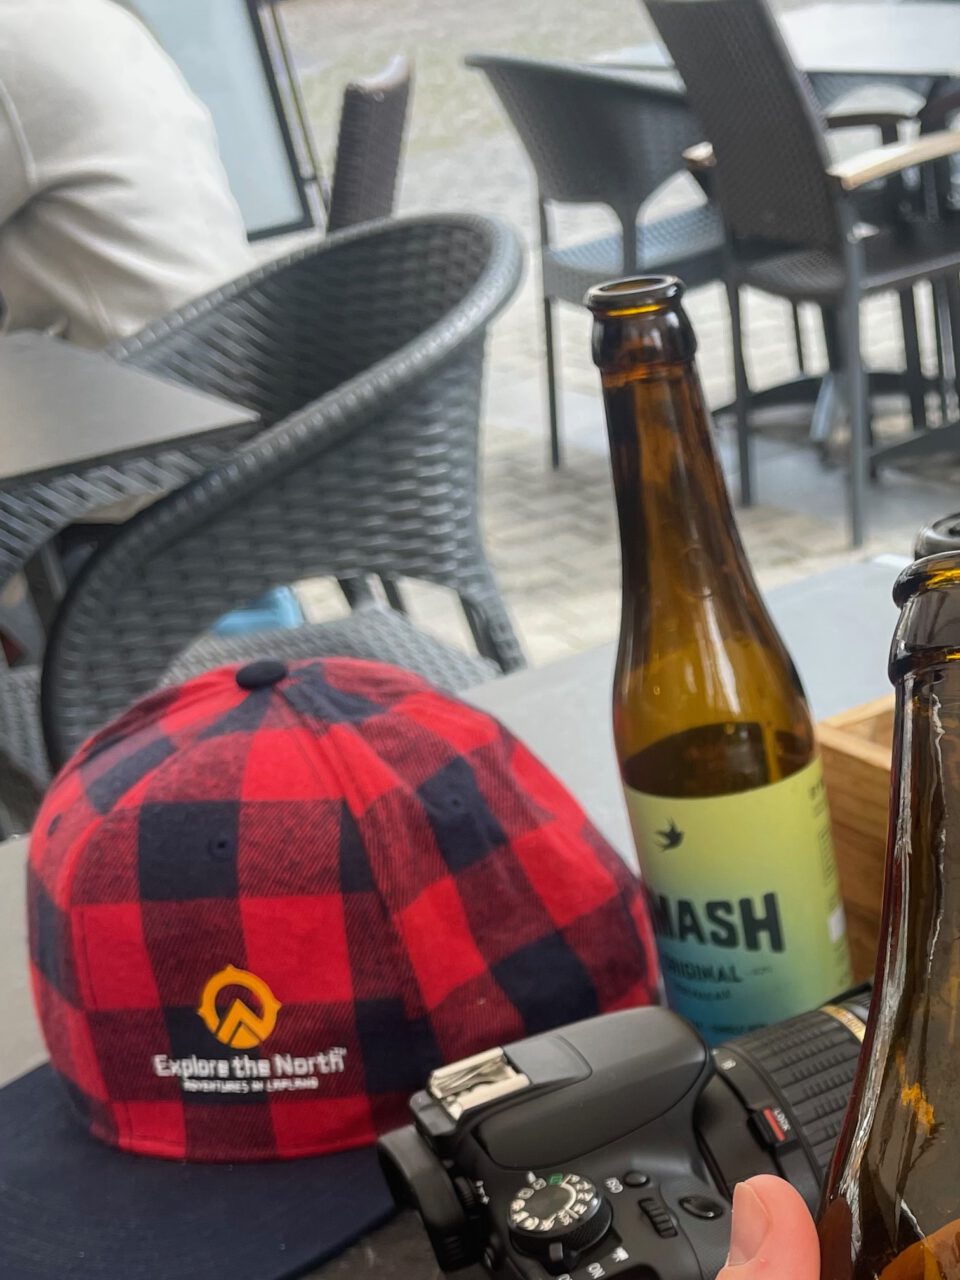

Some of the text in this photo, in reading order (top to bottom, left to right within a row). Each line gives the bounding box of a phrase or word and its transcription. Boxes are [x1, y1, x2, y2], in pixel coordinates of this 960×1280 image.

[153, 1052, 345, 1081] Explore the North
[587, 1262, 606, 1280] ON
